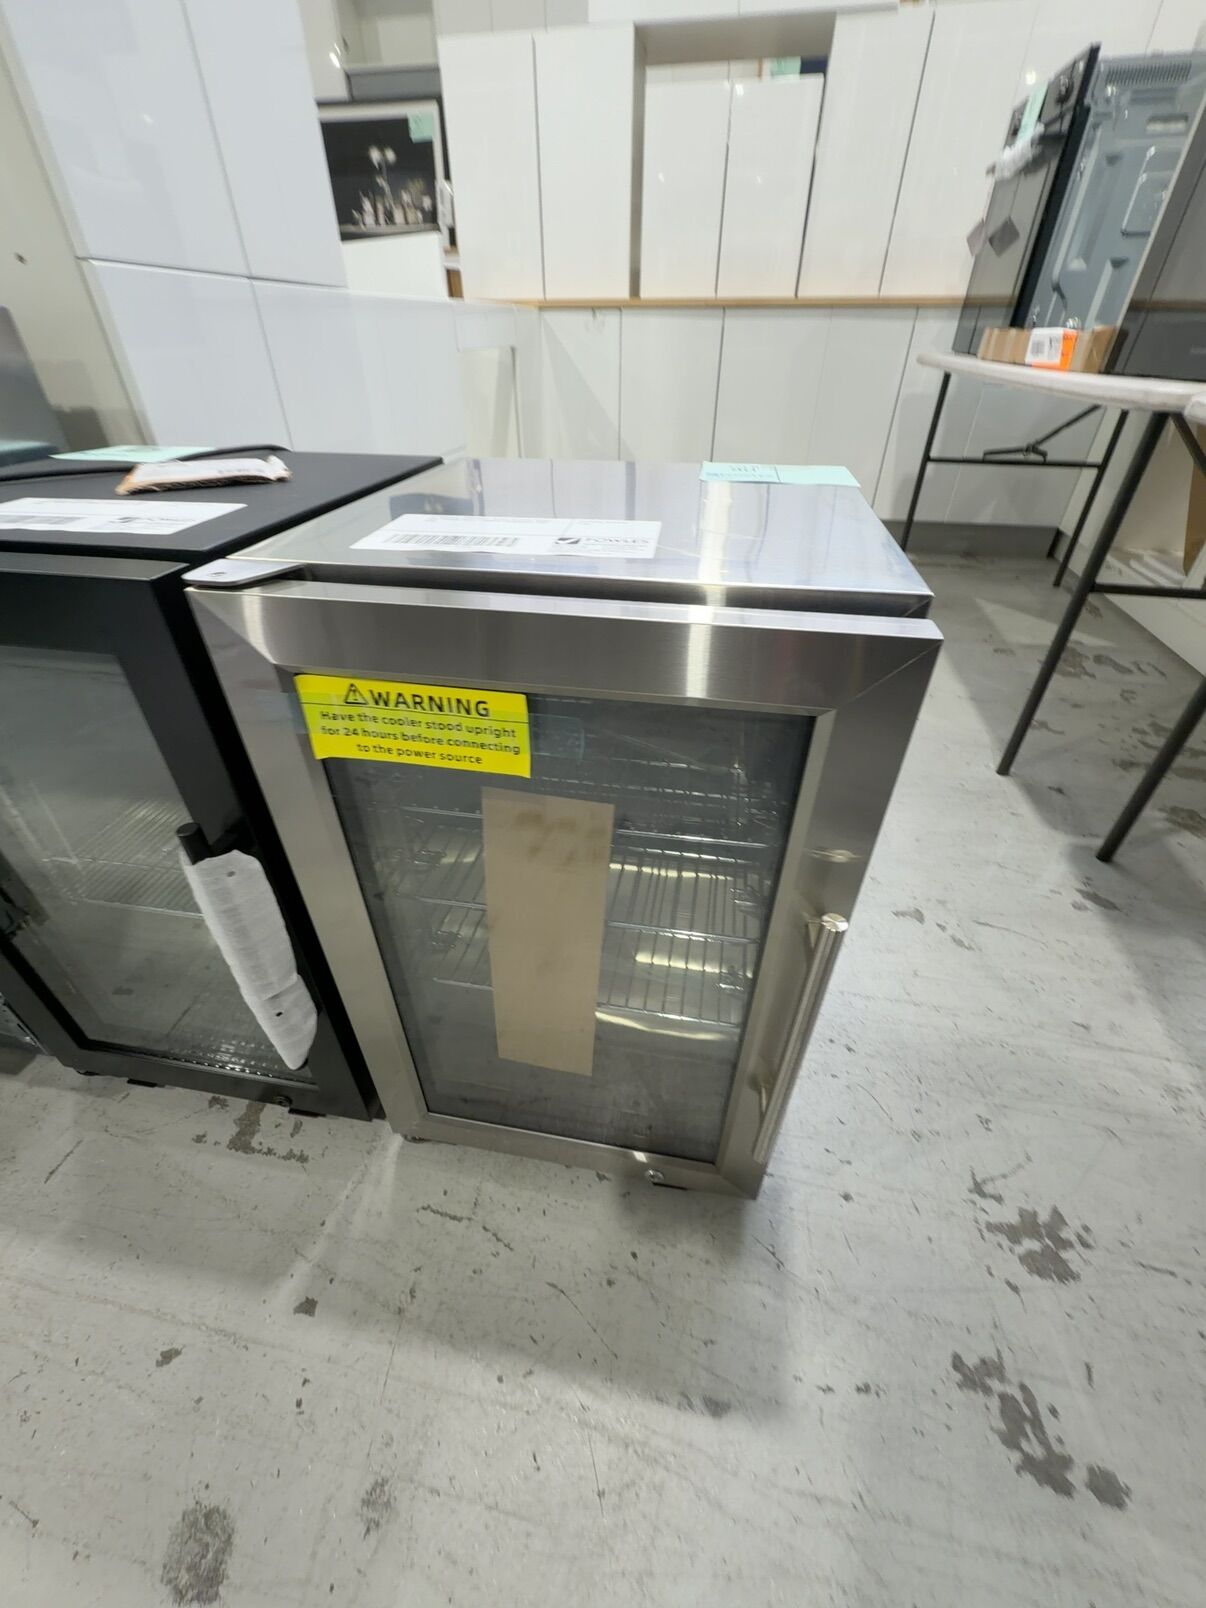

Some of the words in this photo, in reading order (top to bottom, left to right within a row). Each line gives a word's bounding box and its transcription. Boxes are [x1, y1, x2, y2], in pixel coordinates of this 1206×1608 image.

[369, 689, 489, 717] WARNING
[320, 711, 354, 722] Have
[358, 713, 379, 723] the
[382, 717, 421, 727] cooler
[425, 720, 463, 731] stood
[466, 725, 517, 738] upright
[321, 725, 340, 736] for
[343, 727, 359, 737] 24
[361, 728, 399, 741] hours
[401, 731, 444, 746] before
[447, 738, 521, 756] connecting
[357, 743, 370, 752] to
[372, 743, 394, 755] the
[396, 747, 436, 759] power
[440, 753, 483, 764] source
